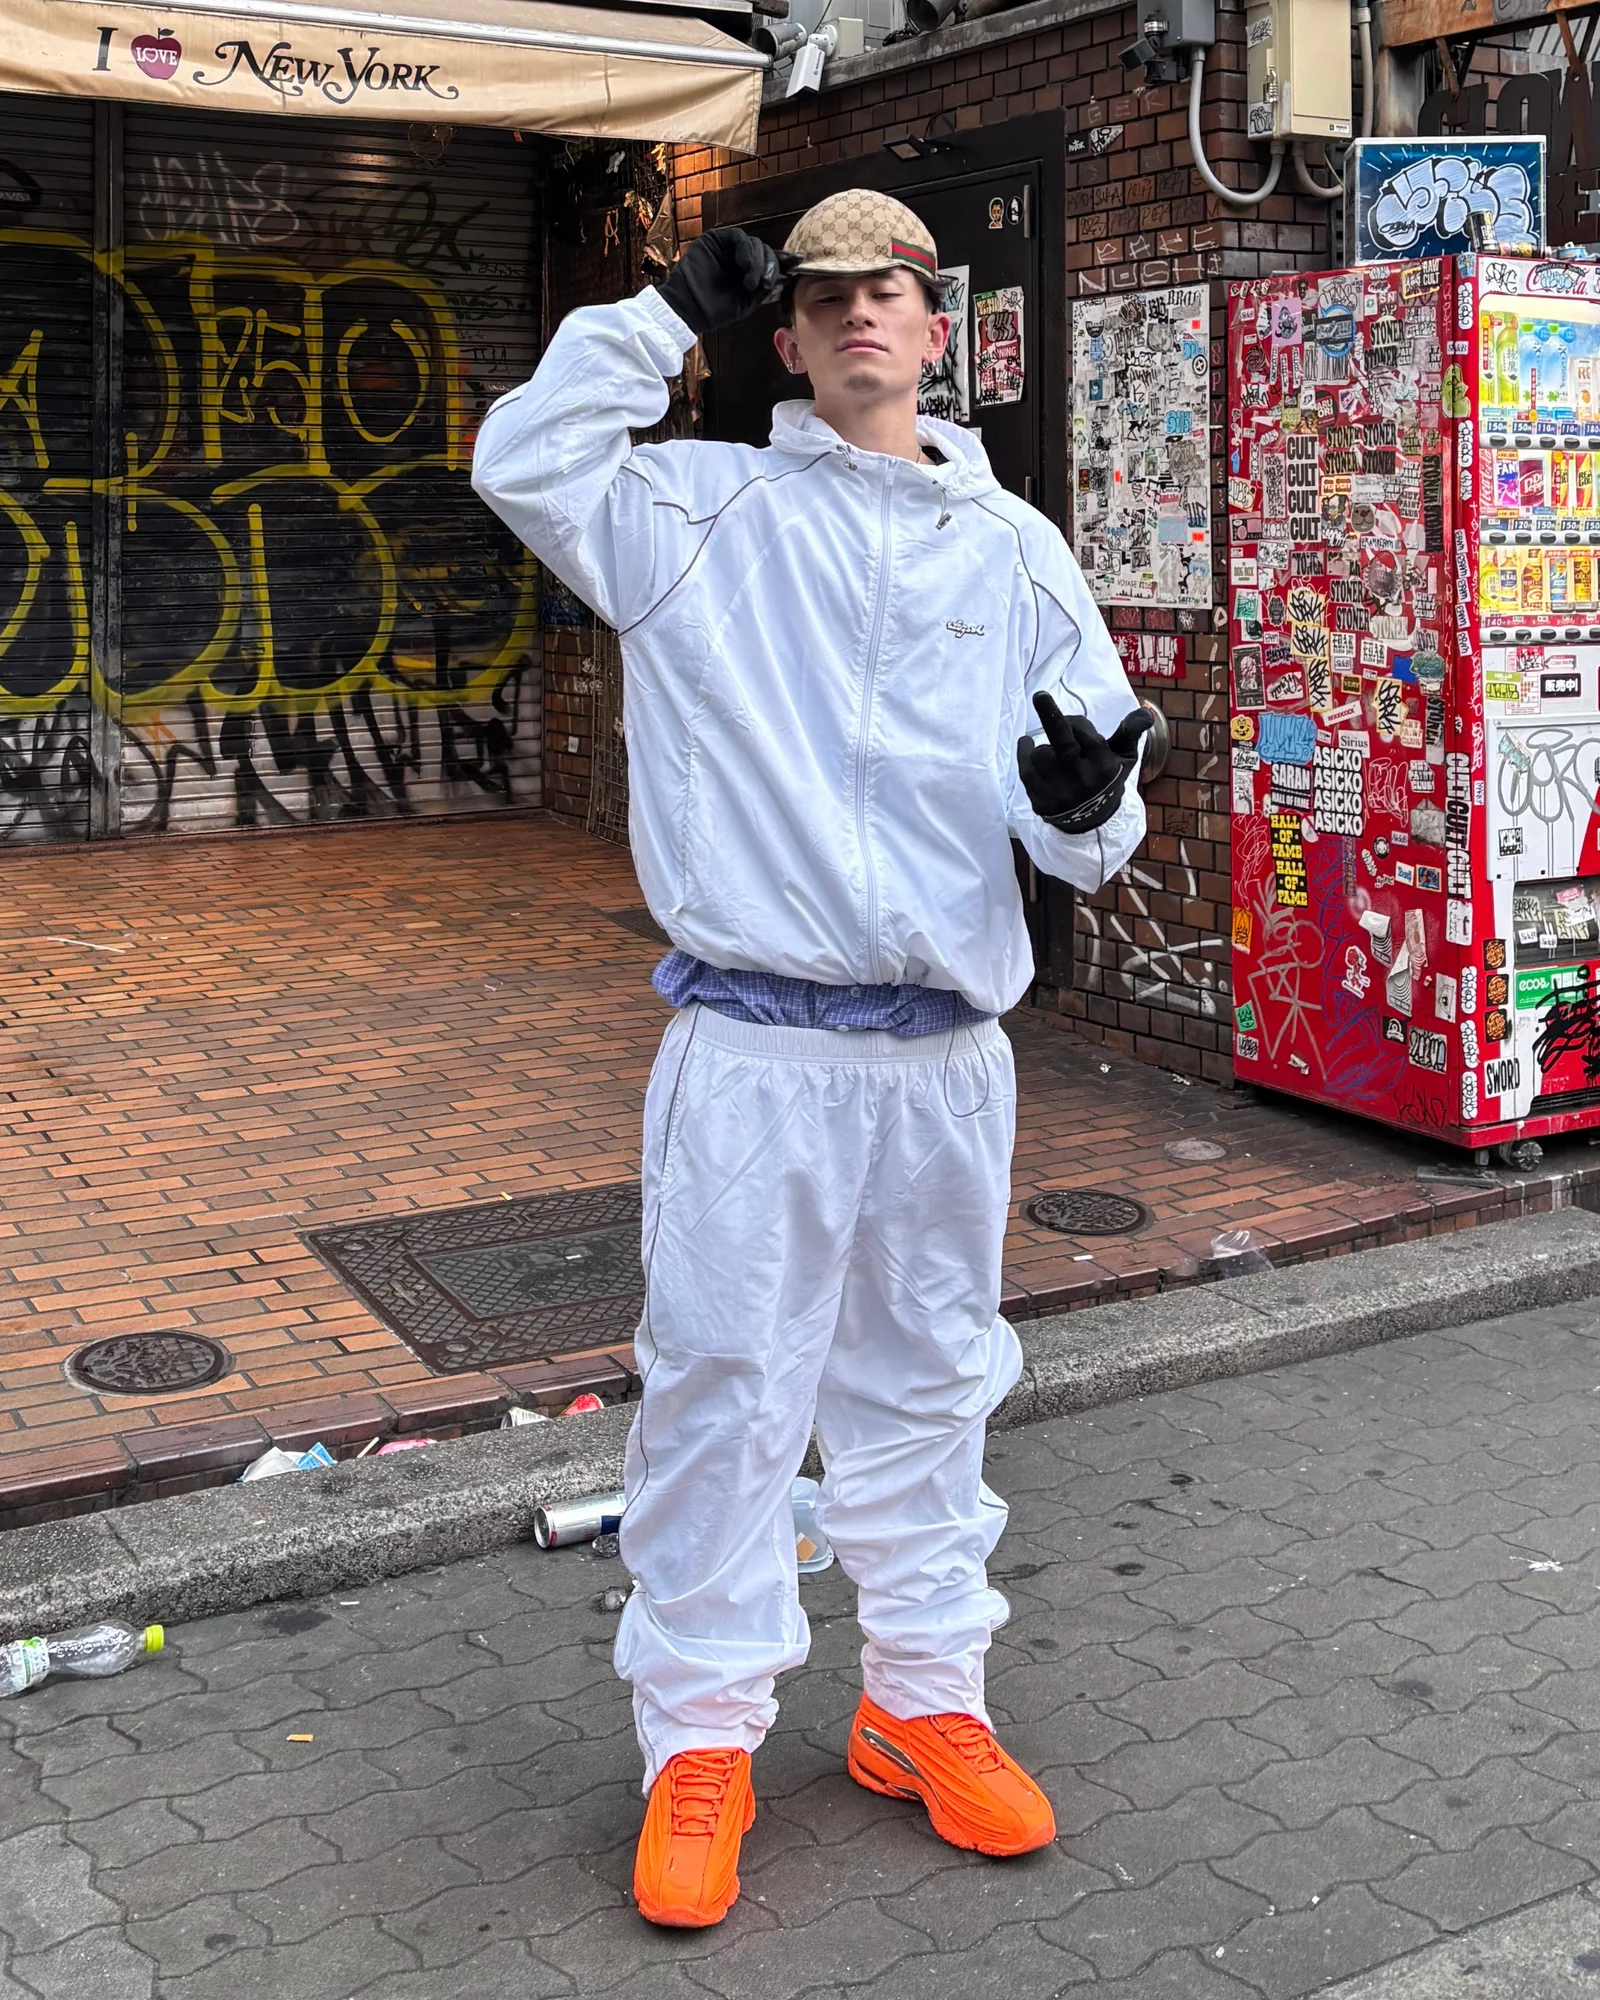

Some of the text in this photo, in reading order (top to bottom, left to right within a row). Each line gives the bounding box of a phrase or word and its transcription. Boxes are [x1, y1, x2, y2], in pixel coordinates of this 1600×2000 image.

[92, 27, 118, 71] I
[136, 46, 178, 66] LOVE
[1423, 272, 1440, 286] CULT
[1370, 320, 1405, 346] STONER
[1364, 346, 1399, 371] STONER
[1363, 423, 1398, 446] STONER
[1287, 436, 1318, 460] CULT
[1325, 451, 1359, 474] STONER
[1287, 463, 1318, 487] CULT
[1288, 490, 1319, 514] CULT
[1289, 517, 1320, 541] CULT
[1292, 552, 1323, 575] TONER
[1331, 580, 1364, 603] STONER
[1337, 607, 1370, 631] STONER
[1340, 735, 1369, 748] Sirius
[1313, 746, 1362, 771] ASICKO
[1271, 763, 1310, 790] SARAN
[1313, 768, 1363, 793] ASICKO
[1446, 752, 1471, 799] CULT
[1271, 792, 1285, 805] HALL
[1294, 796, 1310, 810] FAME
[1313, 789, 1363, 814] ASICKO
[1271, 814, 1300, 829] HALL
[1314, 811, 1363, 836] ASICKO
[1280, 830, 1293, 840] OF
[1272, 843, 1303, 859] FAME
[1276, 860, 1306, 876] HALL
[1285, 877, 1298, 889] OF
[1277, 890, 1308, 906] FAME
[1486, 1057, 1521, 1095] SWORD
